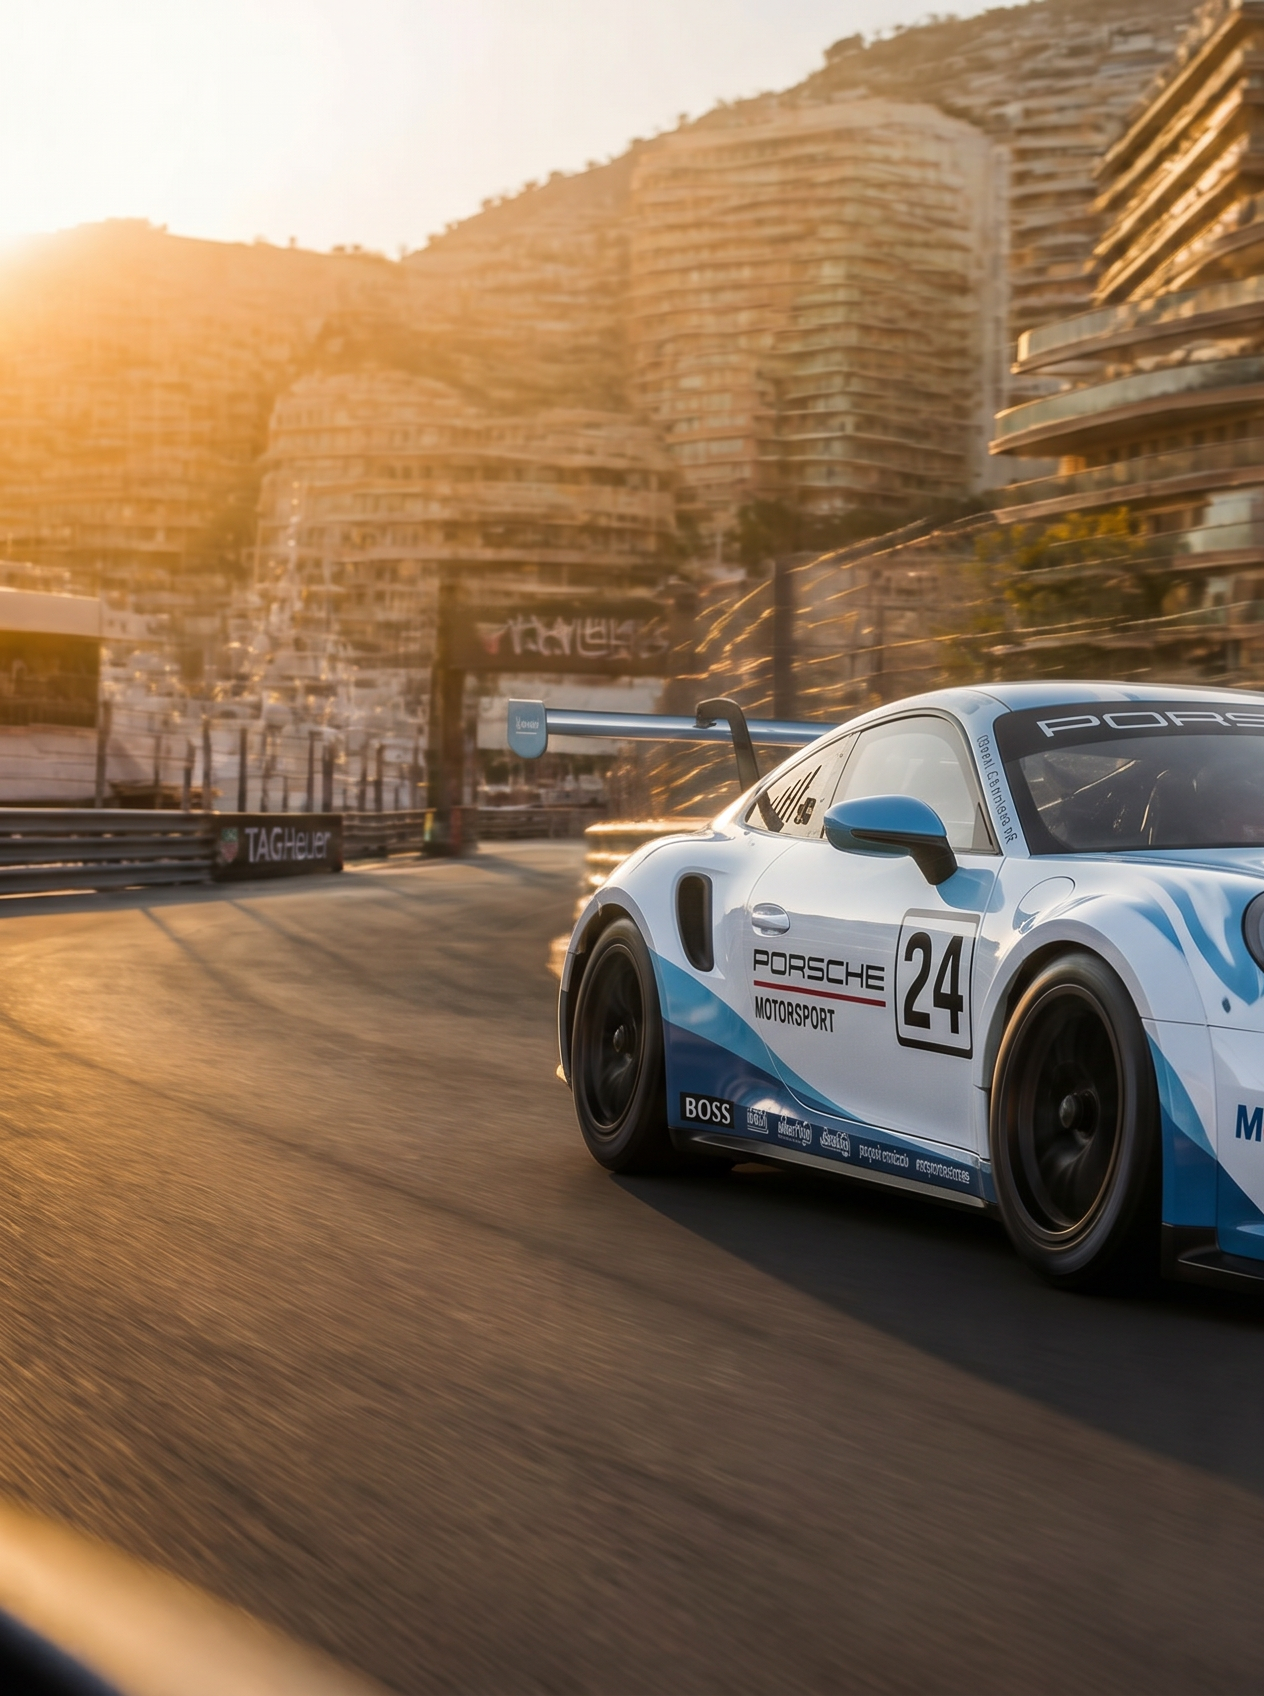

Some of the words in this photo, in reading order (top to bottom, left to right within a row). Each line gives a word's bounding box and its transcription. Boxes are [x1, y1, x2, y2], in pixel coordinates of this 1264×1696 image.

[753, 949, 885, 991] PORSCHE
[904, 932, 963, 1034] 24
[755, 996, 835, 1032] MOTORSPORT
[685, 1097, 731, 1125] BOSS
